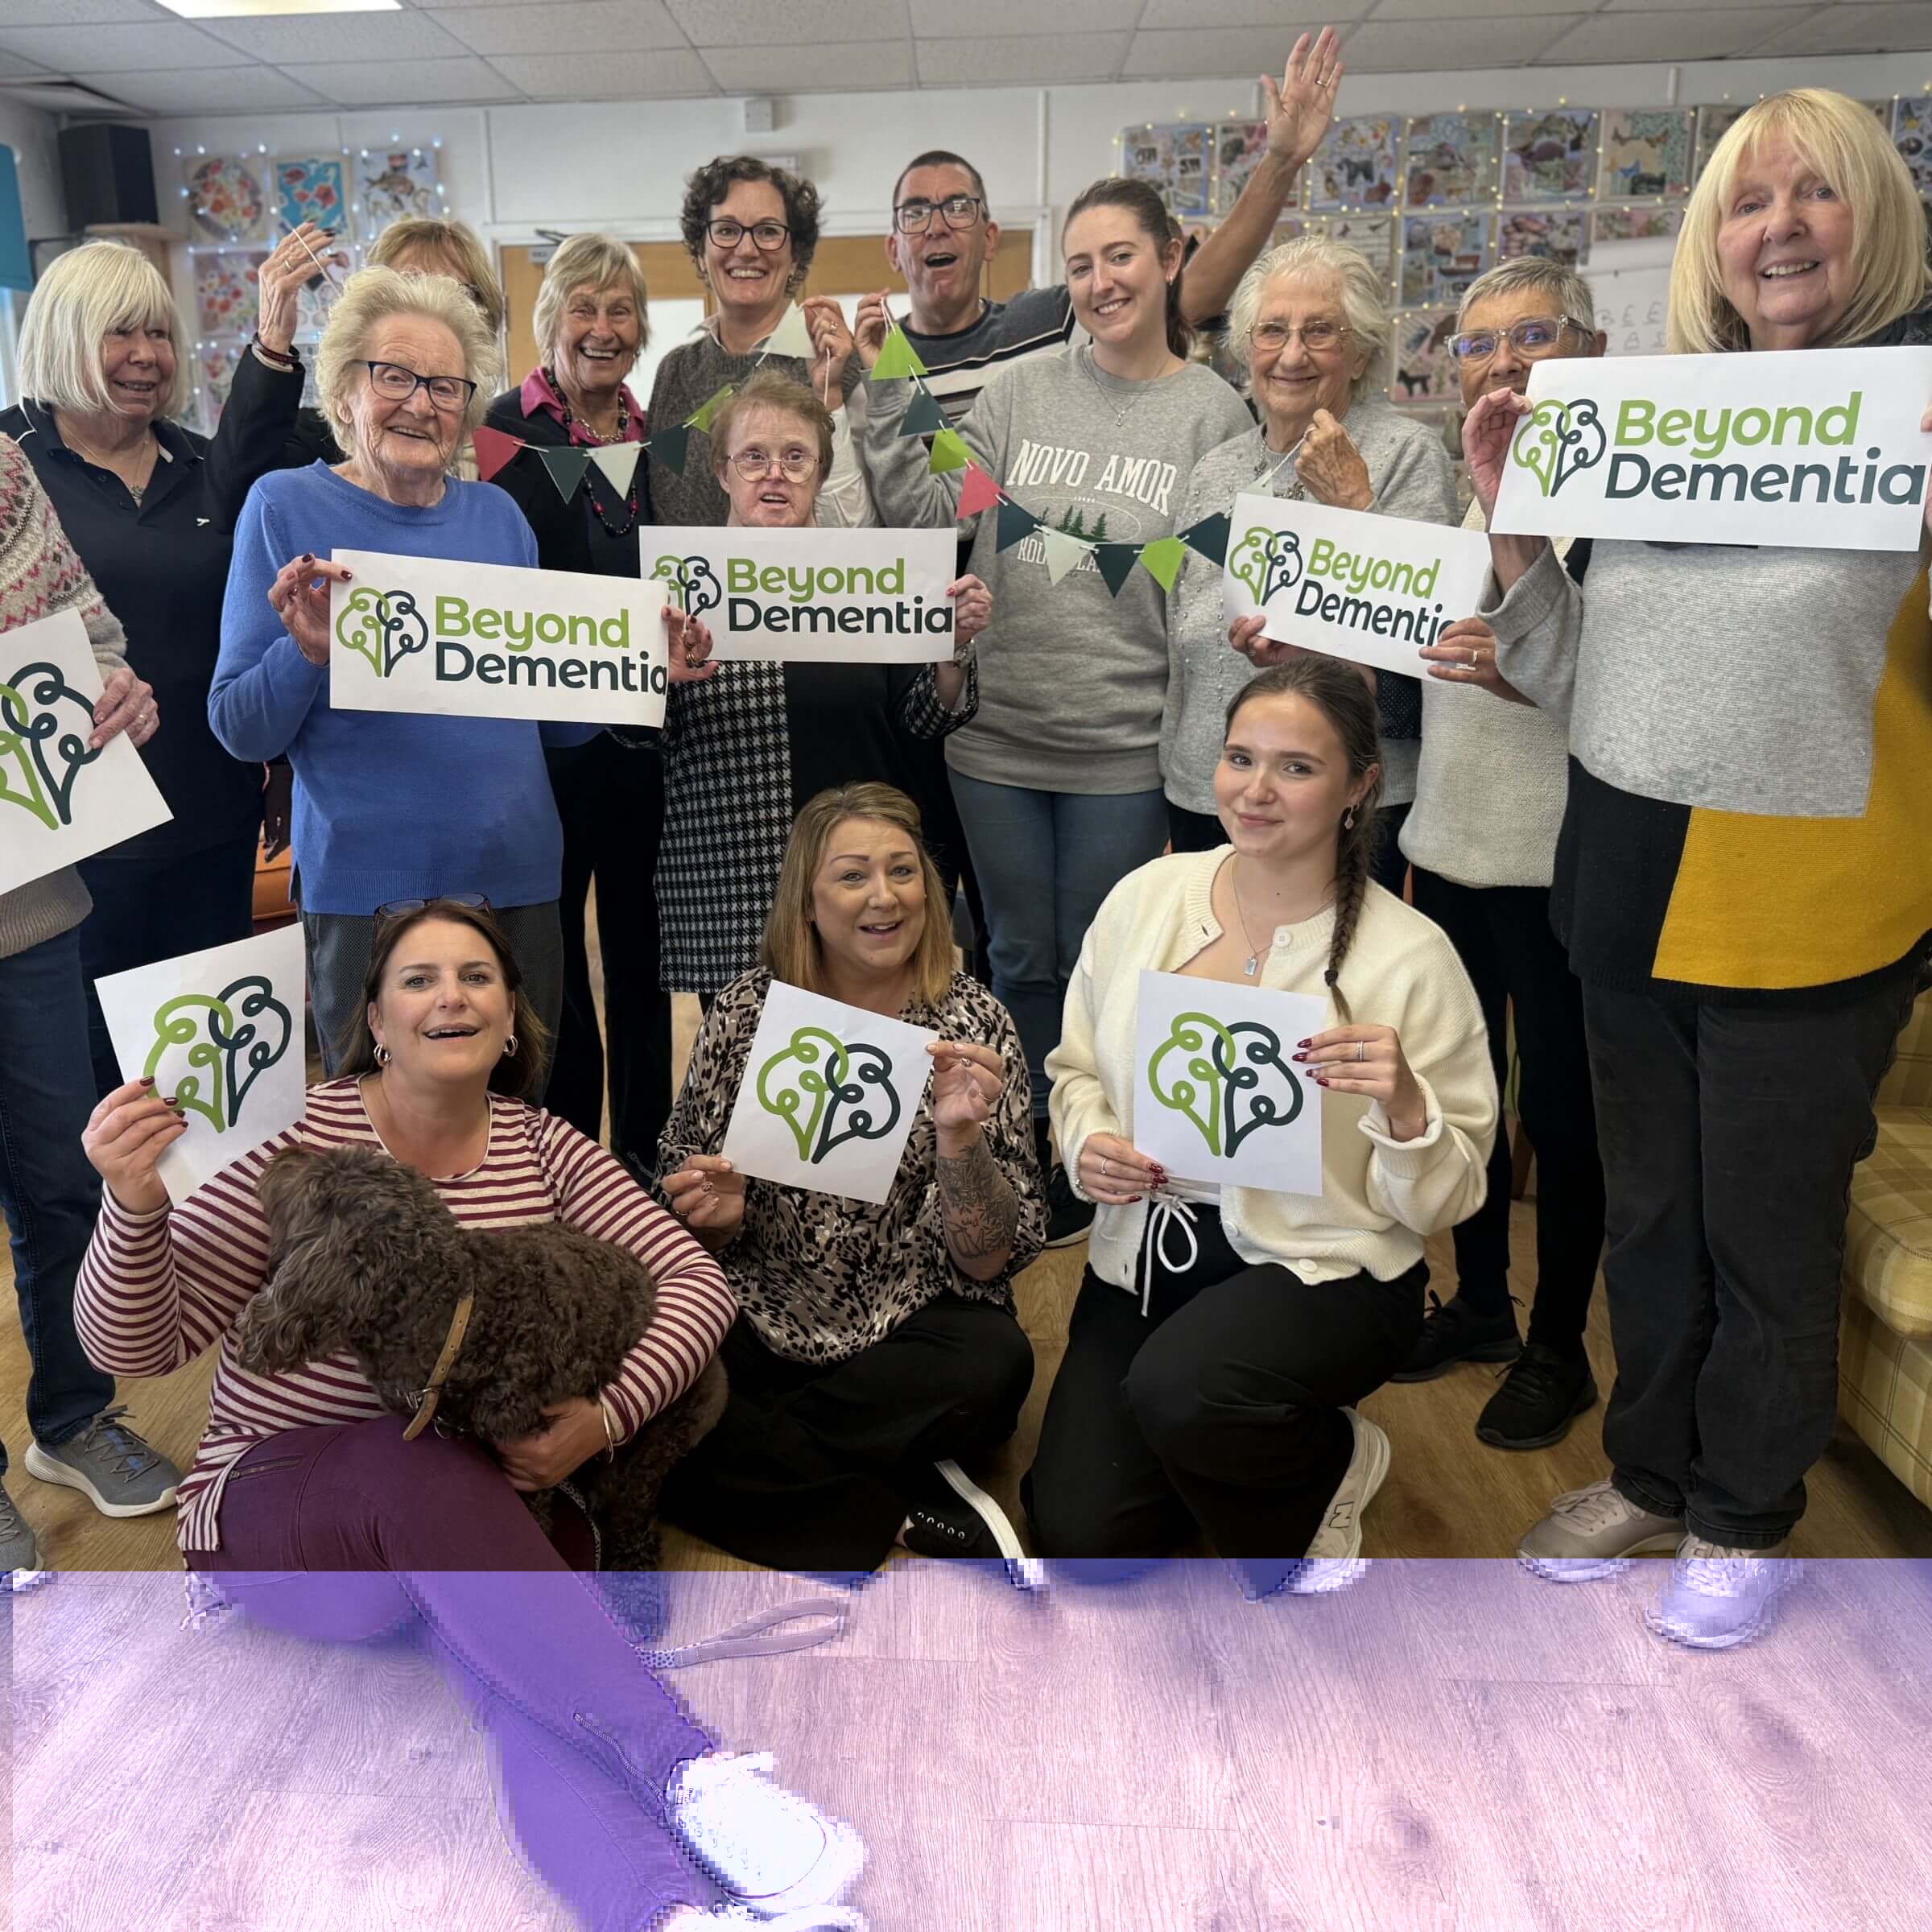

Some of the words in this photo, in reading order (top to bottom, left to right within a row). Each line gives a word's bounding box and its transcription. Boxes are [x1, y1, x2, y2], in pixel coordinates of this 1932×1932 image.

[1614, 391, 1862, 459] Beyond
[1006, 439, 1090, 487] NOVO
[1094, 454, 1178, 517] AMOR
[1604, 447, 1926, 505] Dementia
[726, 558, 905, 603] Beyond
[1307, 539, 1441, 599] Beyond
[436, 596, 630, 652] Beyond
[728, 595, 953, 634] Dementia
[436, 641, 667, 696] Dementia
